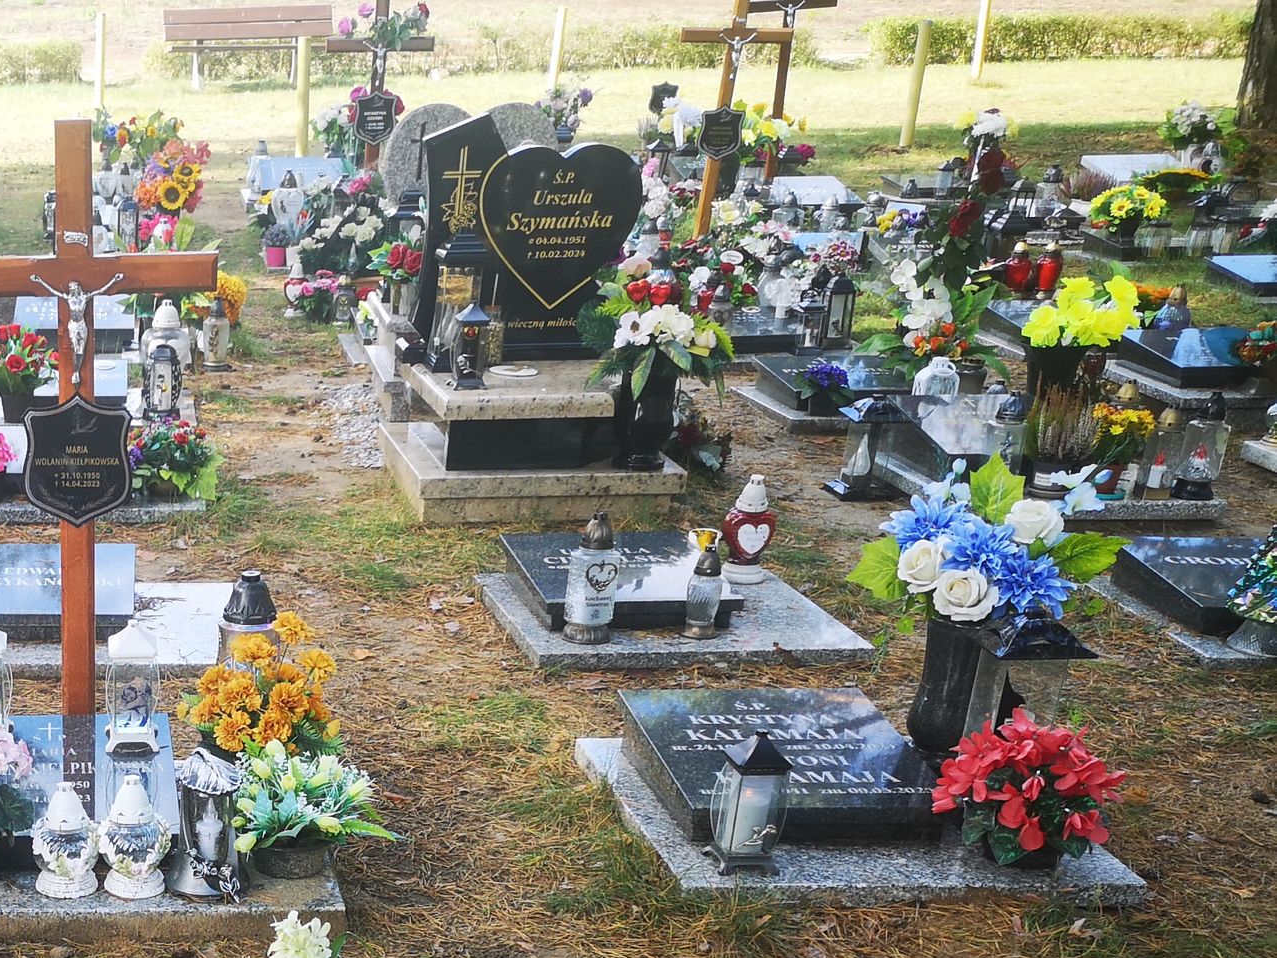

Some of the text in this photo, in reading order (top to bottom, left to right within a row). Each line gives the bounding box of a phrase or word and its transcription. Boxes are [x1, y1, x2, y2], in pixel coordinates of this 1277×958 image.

[553, 168, 575, 184] Ś.P.
[533, 189, 593, 206] Urszula
[507, 210, 613, 235] Szymańska
[536, 236, 586, 245] 04.04.1951
[534, 250, 586, 259] 10.02.2024
[507, 318, 545, 331] wieczną
[65, 445, 89, 454] MARIA
[35, 457, 120, 466] WOLANIN-KIEŁPIKOWSKA
[688, 714, 838, 725] KRYSTYNA
[786, 755, 851, 766] TONI
